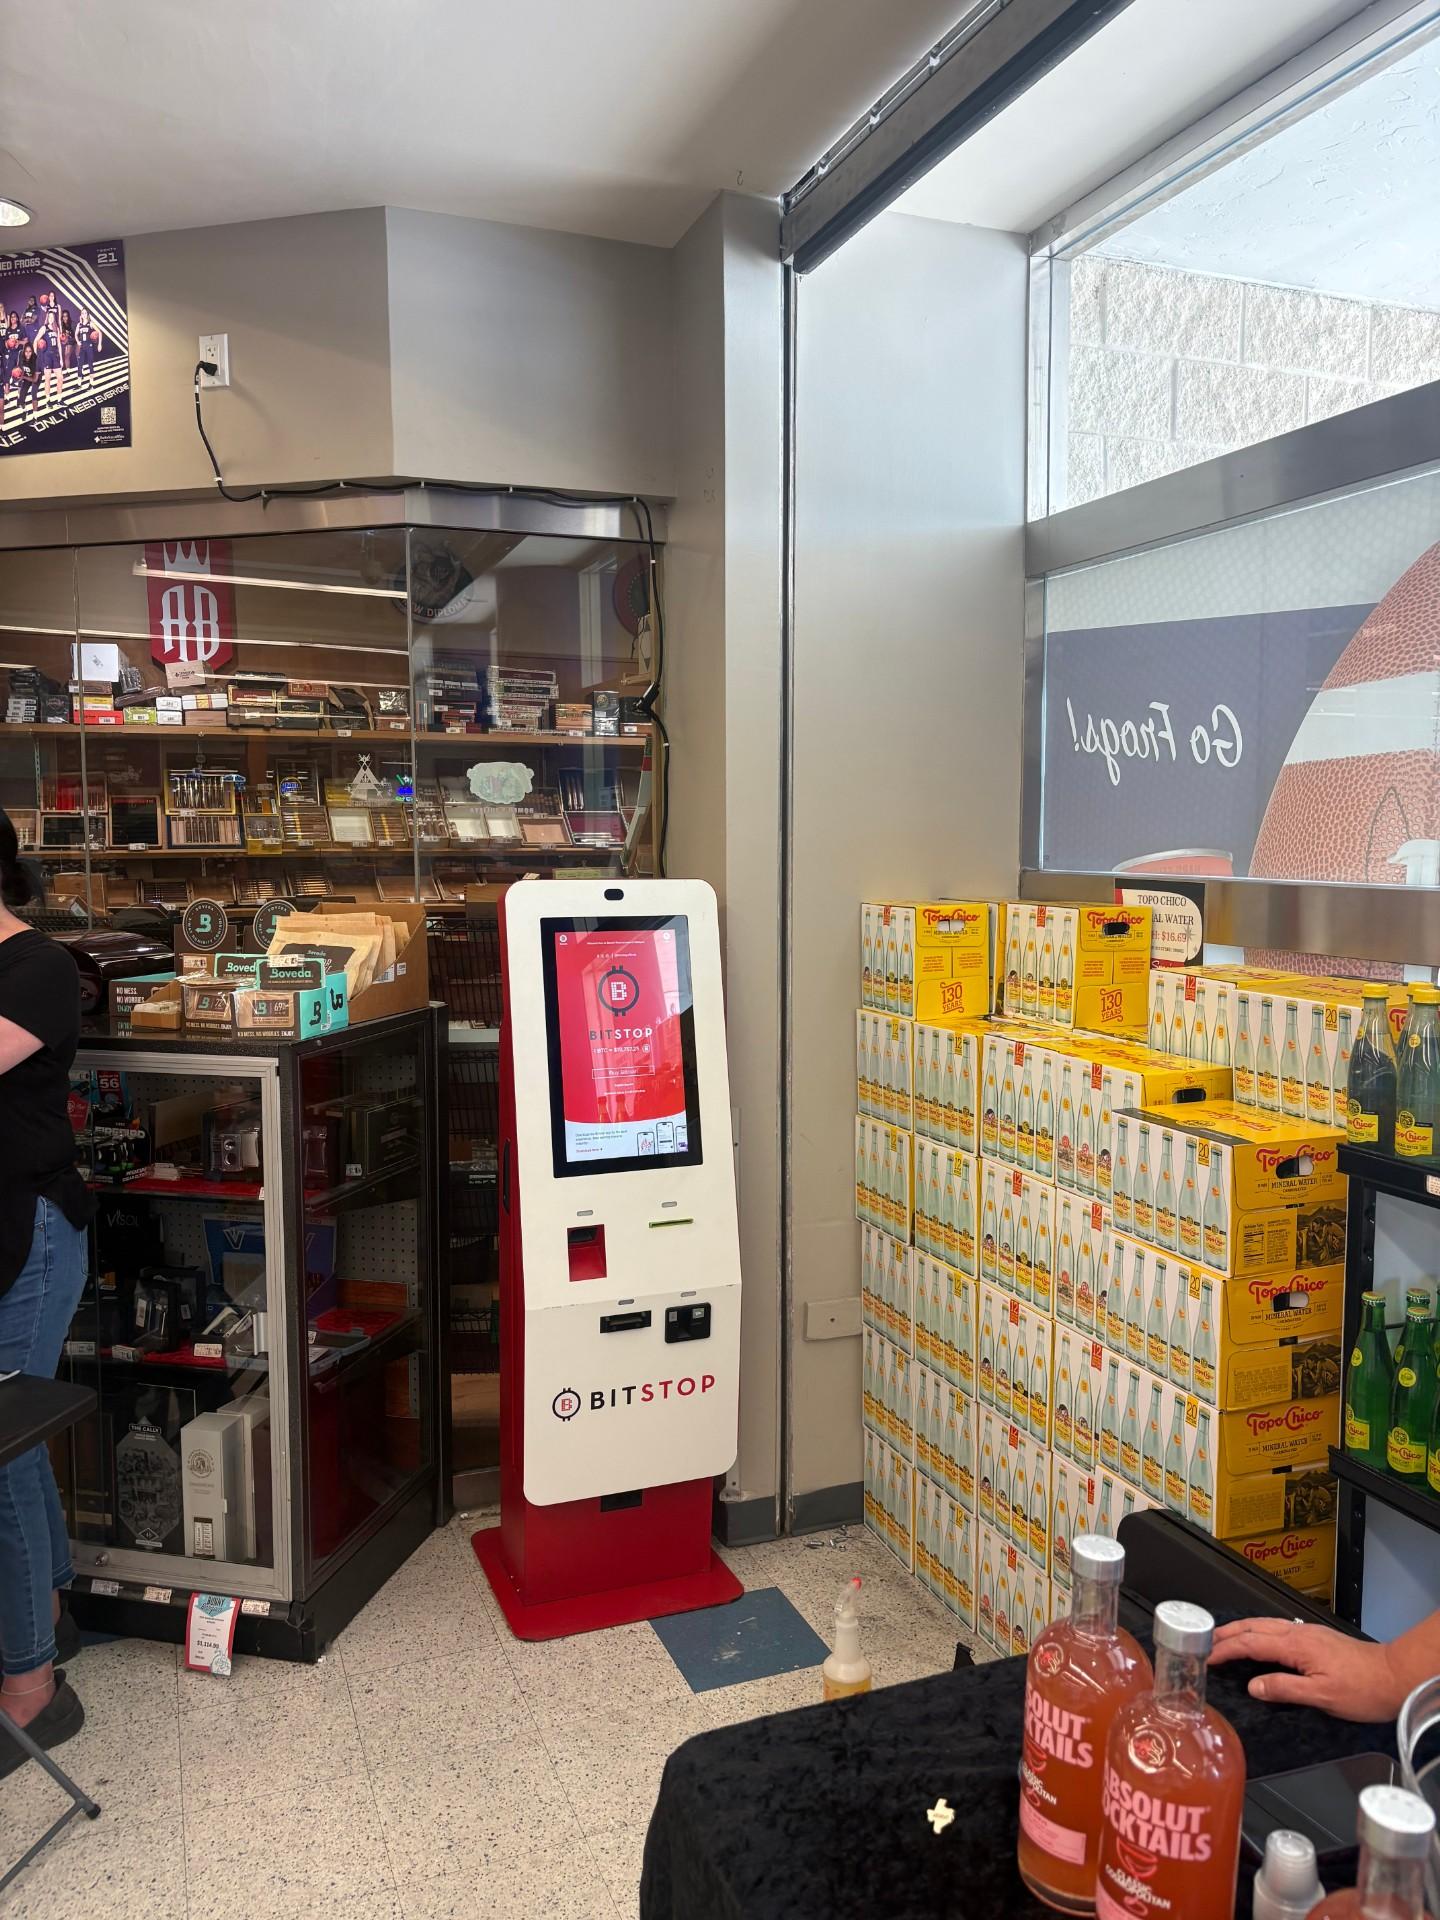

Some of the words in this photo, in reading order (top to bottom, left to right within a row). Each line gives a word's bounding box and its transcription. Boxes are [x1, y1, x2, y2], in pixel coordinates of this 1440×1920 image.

[14, 257, 41, 270] FROGS
[97, 253, 118, 264] 21
[31, 410, 69, 433] ONLY
[68, 399, 97, 417] NEED
[94, 382, 130, 404] EVERYONE
[1137, 894, 1159, 905] TOPO
[1160, 895, 1187, 907] CHICO
[1164, 913, 1194, 926] WATER
[1161, 930, 1187, 943] $16.69
[225, 961, 256, 973] Boved
[269, 967, 312, 978] Boveda
[1186, 975, 1196, 989] 12
[942, 984, 963, 1005] 130
[1101, 989, 1123, 1013] 130
[942, 1000, 963, 1013] YEARS
[1101, 1007, 1122, 1020] YEARS
[1325, 1008, 1337, 1024] 20
[589, 1027, 653, 1041] BITSTOP
[1015, 1041, 1024, 1054] 12
[1092, 1064, 1101, 1077] 12
[1352, 1117, 1377, 1130] Chico
[1405, 1129, 1430, 1143] Chico
[1198, 1142, 1209, 1159] 20
[1271, 1180, 1297, 1189] MINERAL
[1298, 1178, 1318, 1186] WATER
[1092, 1202, 1102, 1217] 12
[1190, 1274, 1201, 1292] 20
[1265, 1310, 1292, 1321] MINERAL
[1292, 1308, 1313, 1318] WATER
[590, 1374, 716, 1411] BITSTOP
[1186, 1400, 1197, 1418] 20
[1246, 1411, 1284, 1437] Topo
[1283, 1405, 1324, 1431] Chico
[1262, 1442, 1288, 1452] MINERAL
[1288, 1437, 1308, 1447] WATER
[1399, 1447, 1424, 1460] Chico
[1243, 1541, 1280, 1561] Topo
[1280, 1534, 1317, 1559] Chico
